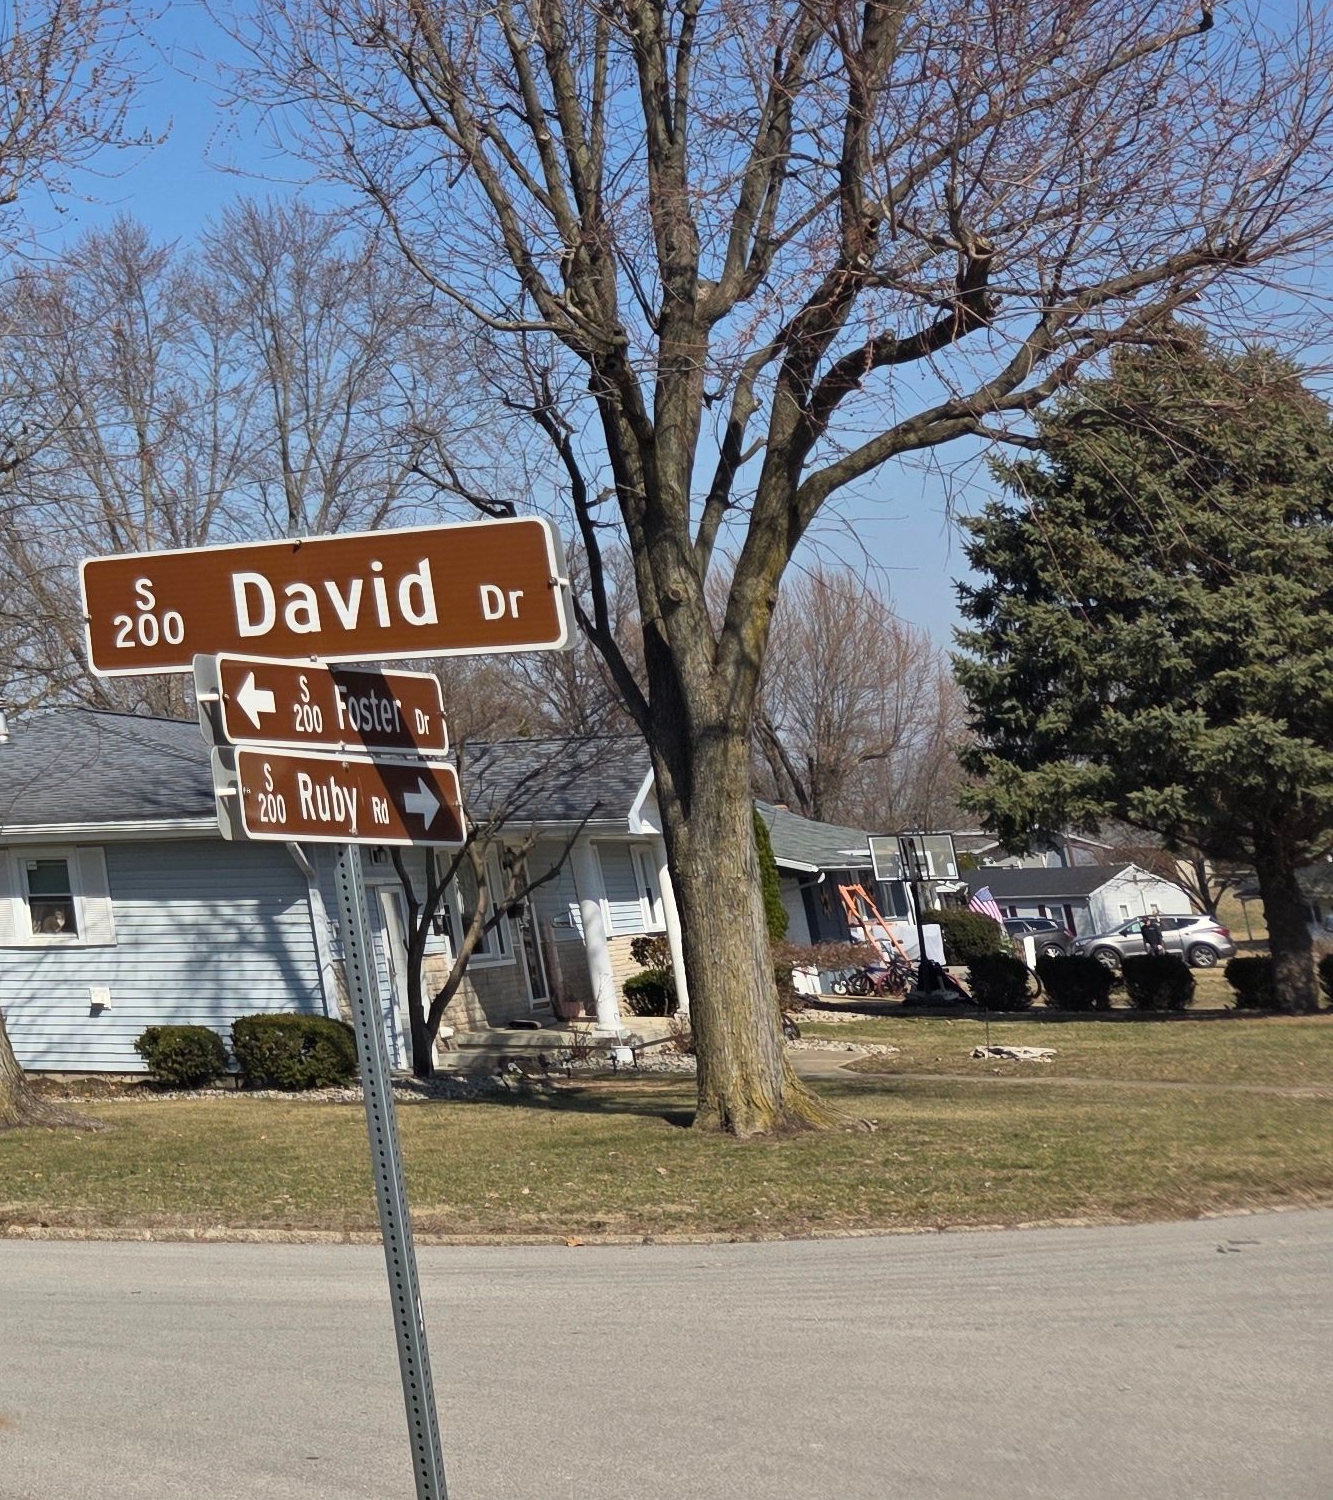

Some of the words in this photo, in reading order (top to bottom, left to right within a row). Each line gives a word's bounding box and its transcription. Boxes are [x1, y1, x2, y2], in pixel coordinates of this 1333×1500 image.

[135, 578, 156, 611] S
[232, 558, 438, 638] David
[480, 584, 524, 621] Dr
[113, 611, 185, 648] 200
[299, 675, 310, 703] S
[293, 704, 323, 733] 200
[336, 685, 402, 734] Foster
[415, 708, 430, 736] Dr
[263, 763, 273, 792] S
[258, 793, 287, 825] 200
[297, 772, 357, 833] Ruby
[372, 796, 390, 825] Rd
